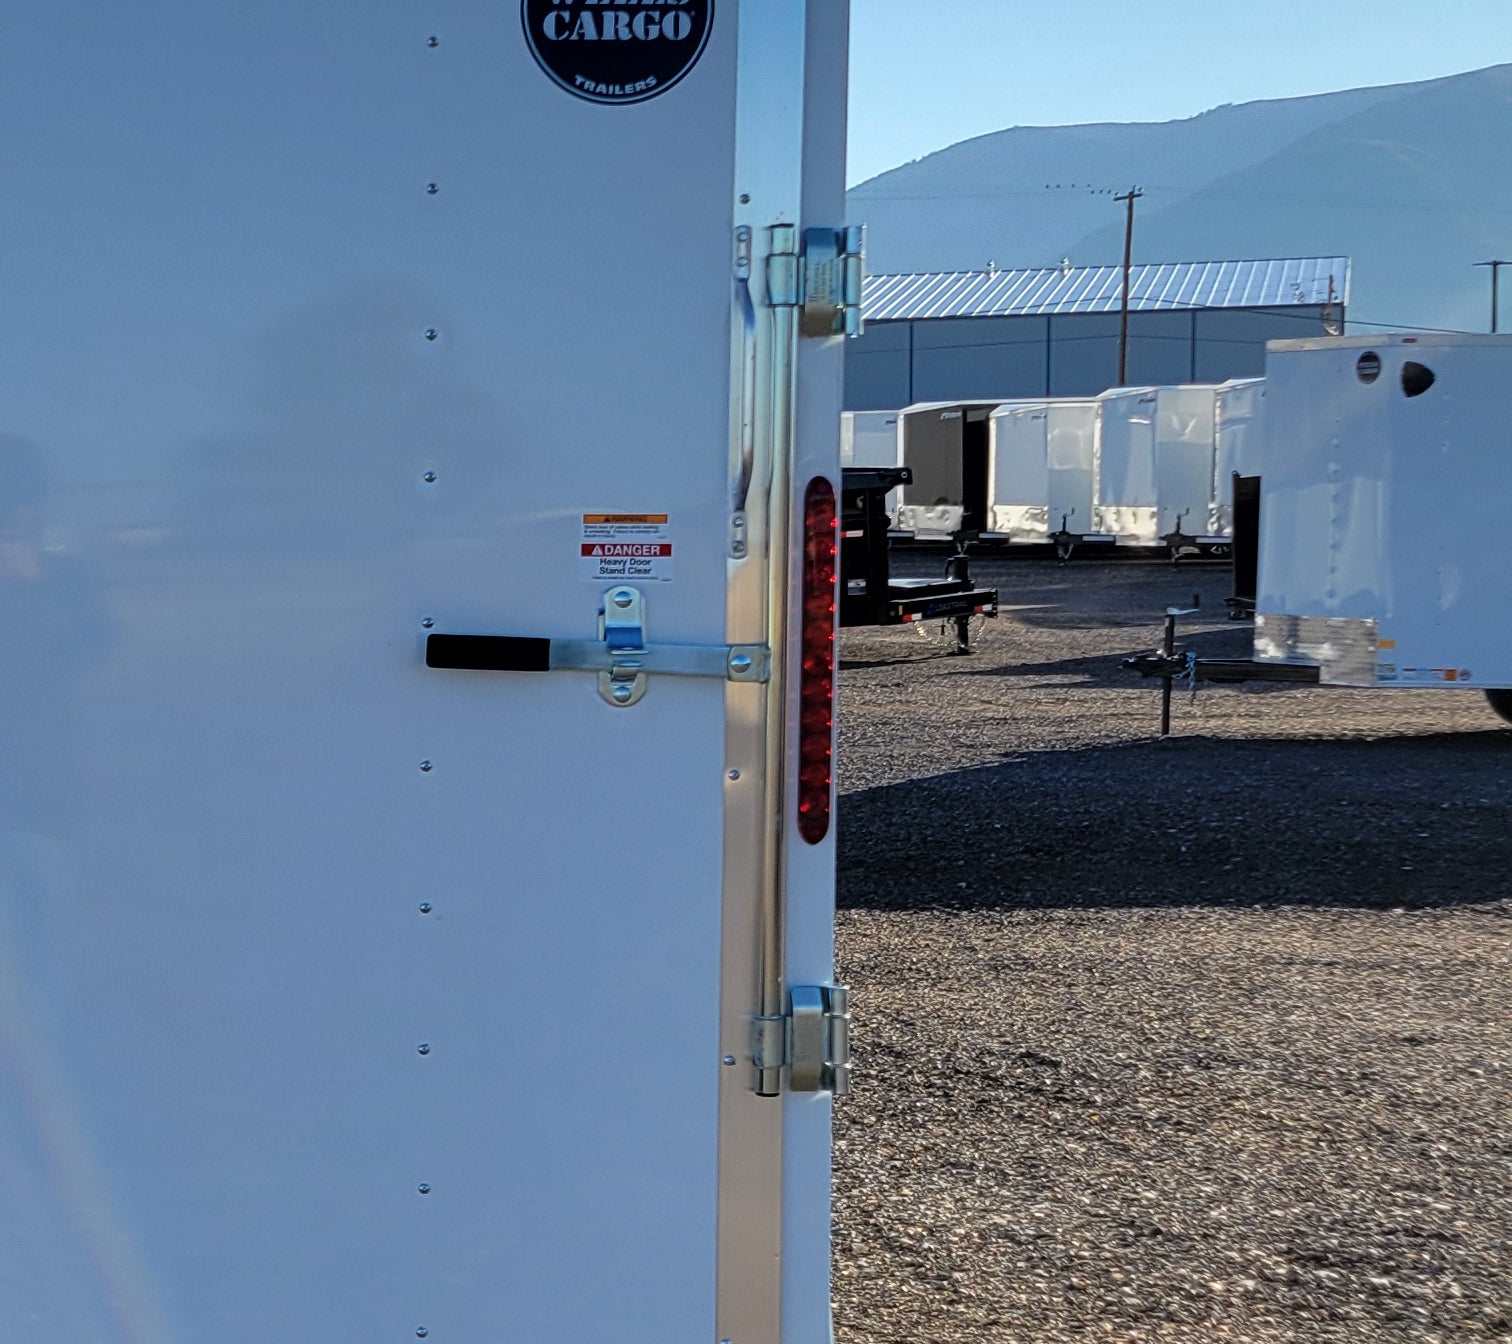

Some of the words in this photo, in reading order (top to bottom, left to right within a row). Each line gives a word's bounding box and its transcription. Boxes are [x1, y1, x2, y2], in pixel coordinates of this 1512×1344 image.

[542, 10, 692, 41] CARGO
[574, 73, 657, 95] TRAILERS
[604, 544, 660, 556] DANGER
[599, 558, 628, 567] Heavy
[629, 558, 652, 566] Door
[599, 566, 626, 575] Stand
[628, 567, 652, 575] Clear
